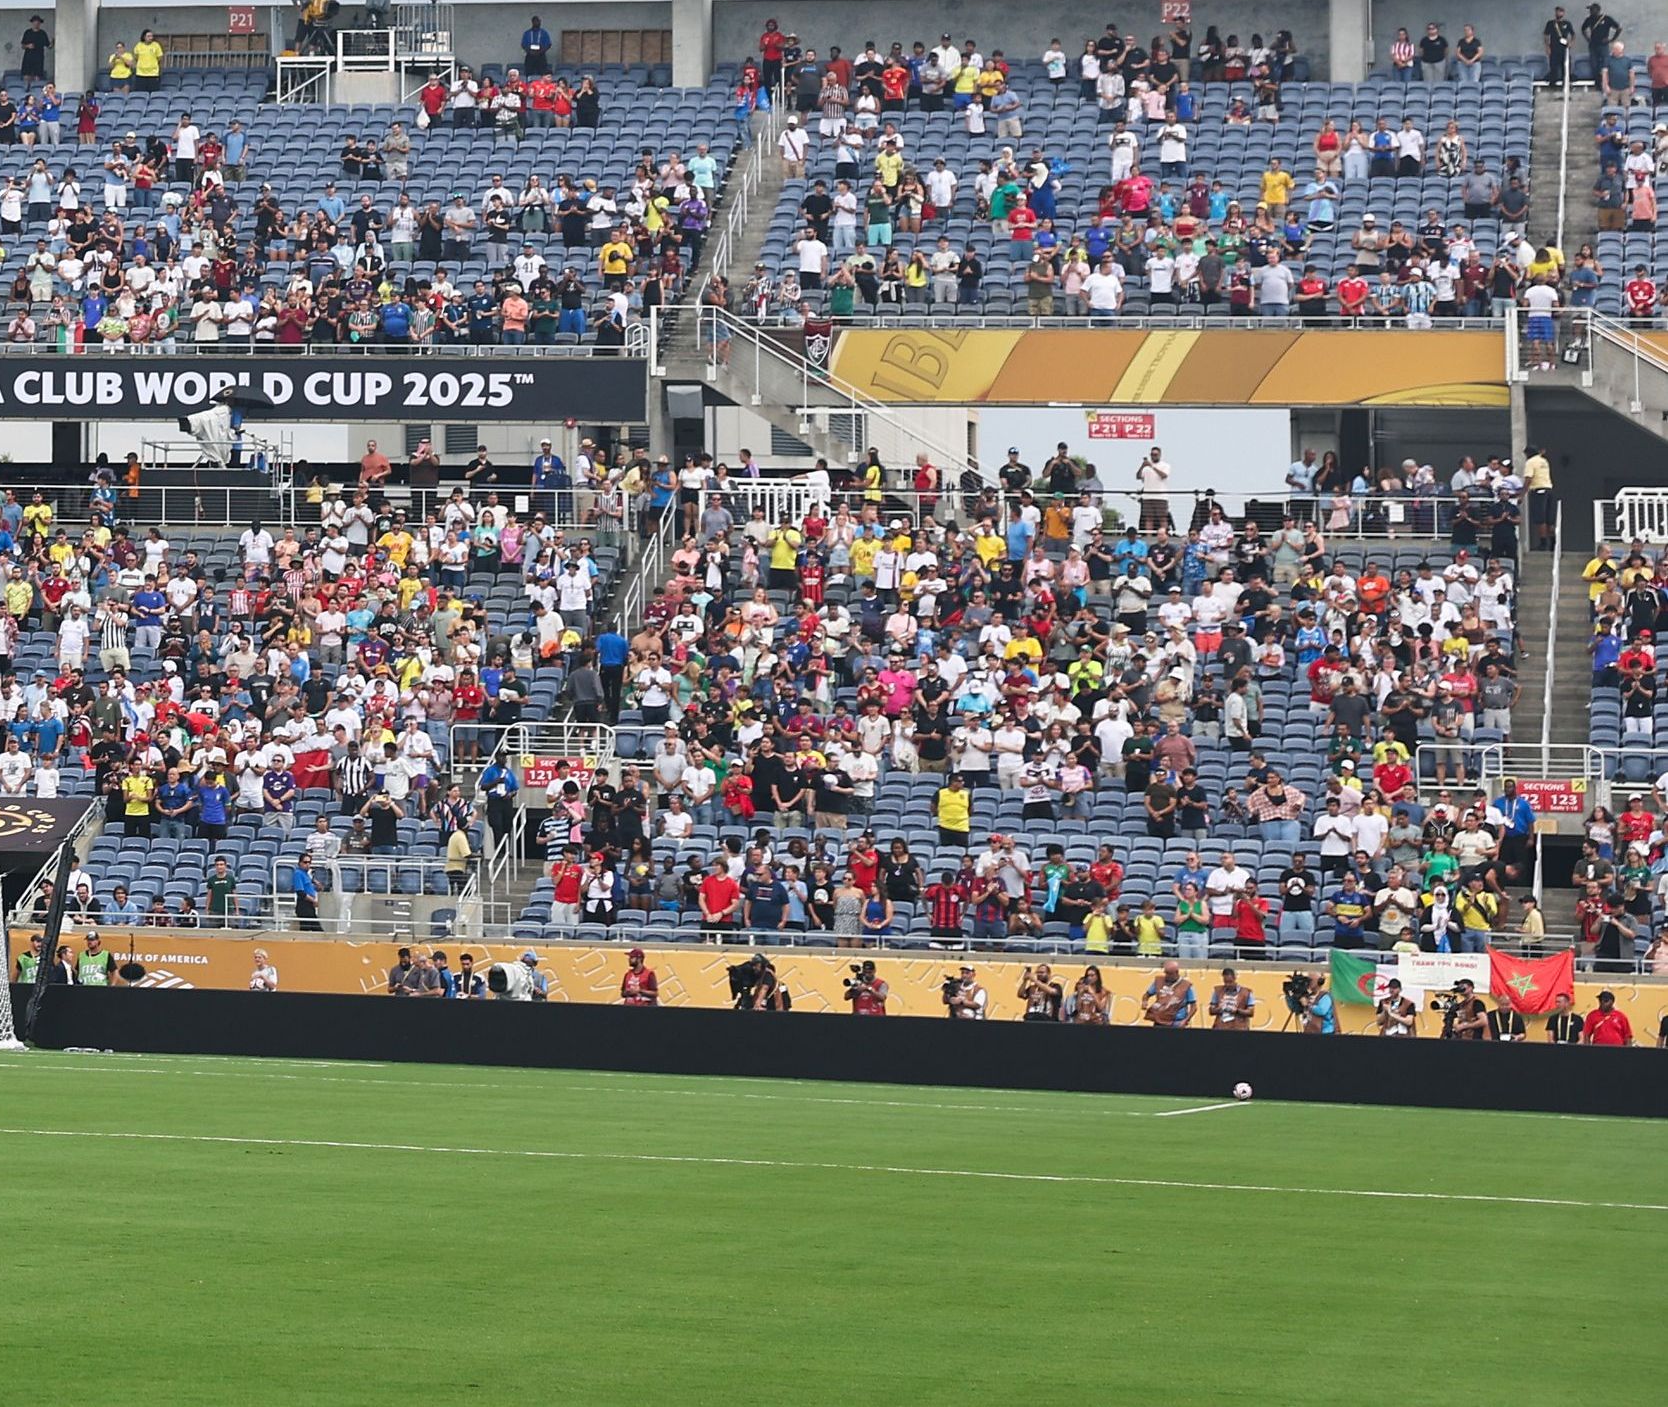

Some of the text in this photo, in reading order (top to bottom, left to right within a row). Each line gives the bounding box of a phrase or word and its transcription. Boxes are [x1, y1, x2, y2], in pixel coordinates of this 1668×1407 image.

[1164, 3, 1189, 16] P22
[230, 13, 252, 26] P21
[14, 372, 122, 404] CLUB
[304, 372, 391, 404] CUP
[529, 770, 552, 780] 121
[1523, 783, 1565, 791] SECTIONS
[1550, 795, 1577, 805] 123
[26, 809, 56, 823] CUP
[114, 952, 208, 964] BANK OF AMERICA
